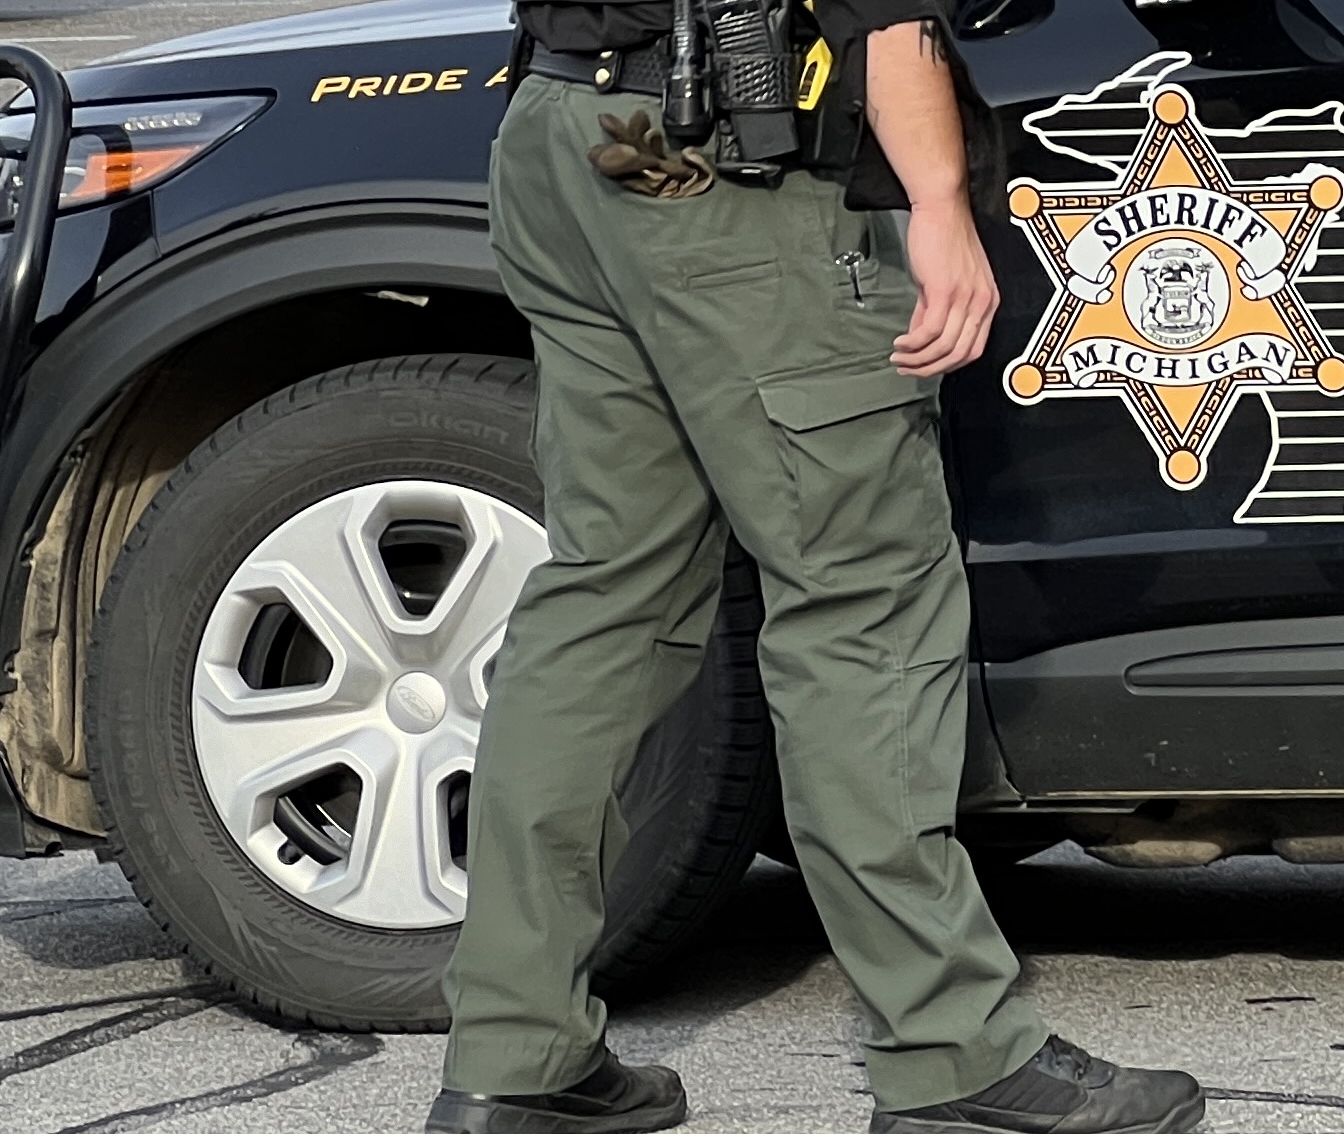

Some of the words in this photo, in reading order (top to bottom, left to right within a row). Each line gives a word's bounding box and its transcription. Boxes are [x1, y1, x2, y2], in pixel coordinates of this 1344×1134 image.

[310, 69, 469, 103] PRIDE
[1093, 192, 1268, 253] SHERIFF
[1069, 340, 1291, 380] MICHIGAN
